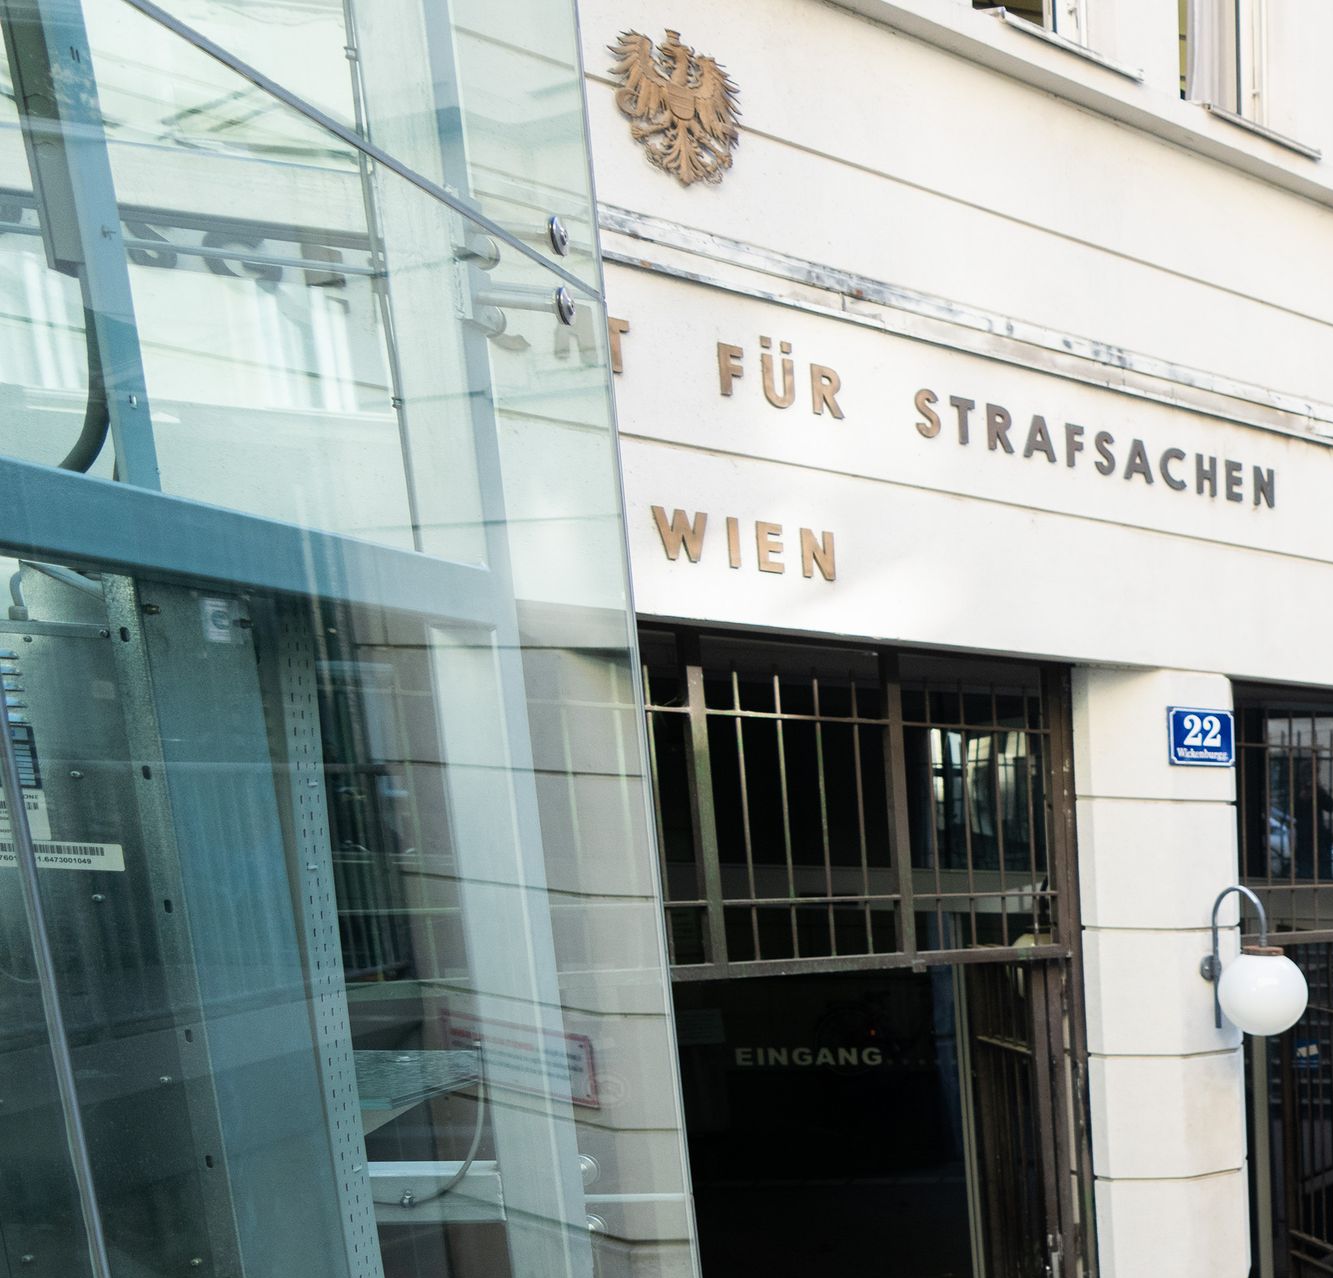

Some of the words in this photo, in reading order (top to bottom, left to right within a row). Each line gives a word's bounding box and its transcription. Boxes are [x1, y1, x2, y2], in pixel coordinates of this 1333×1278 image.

[717, 335, 845, 421] FÜR
[913, 388, 1276, 510] STRAFSACHEN
[650, 505, 838, 582] WIEN
[1183, 714, 1222, 747] 22
[735, 1047, 883, 1066] EINGANG
